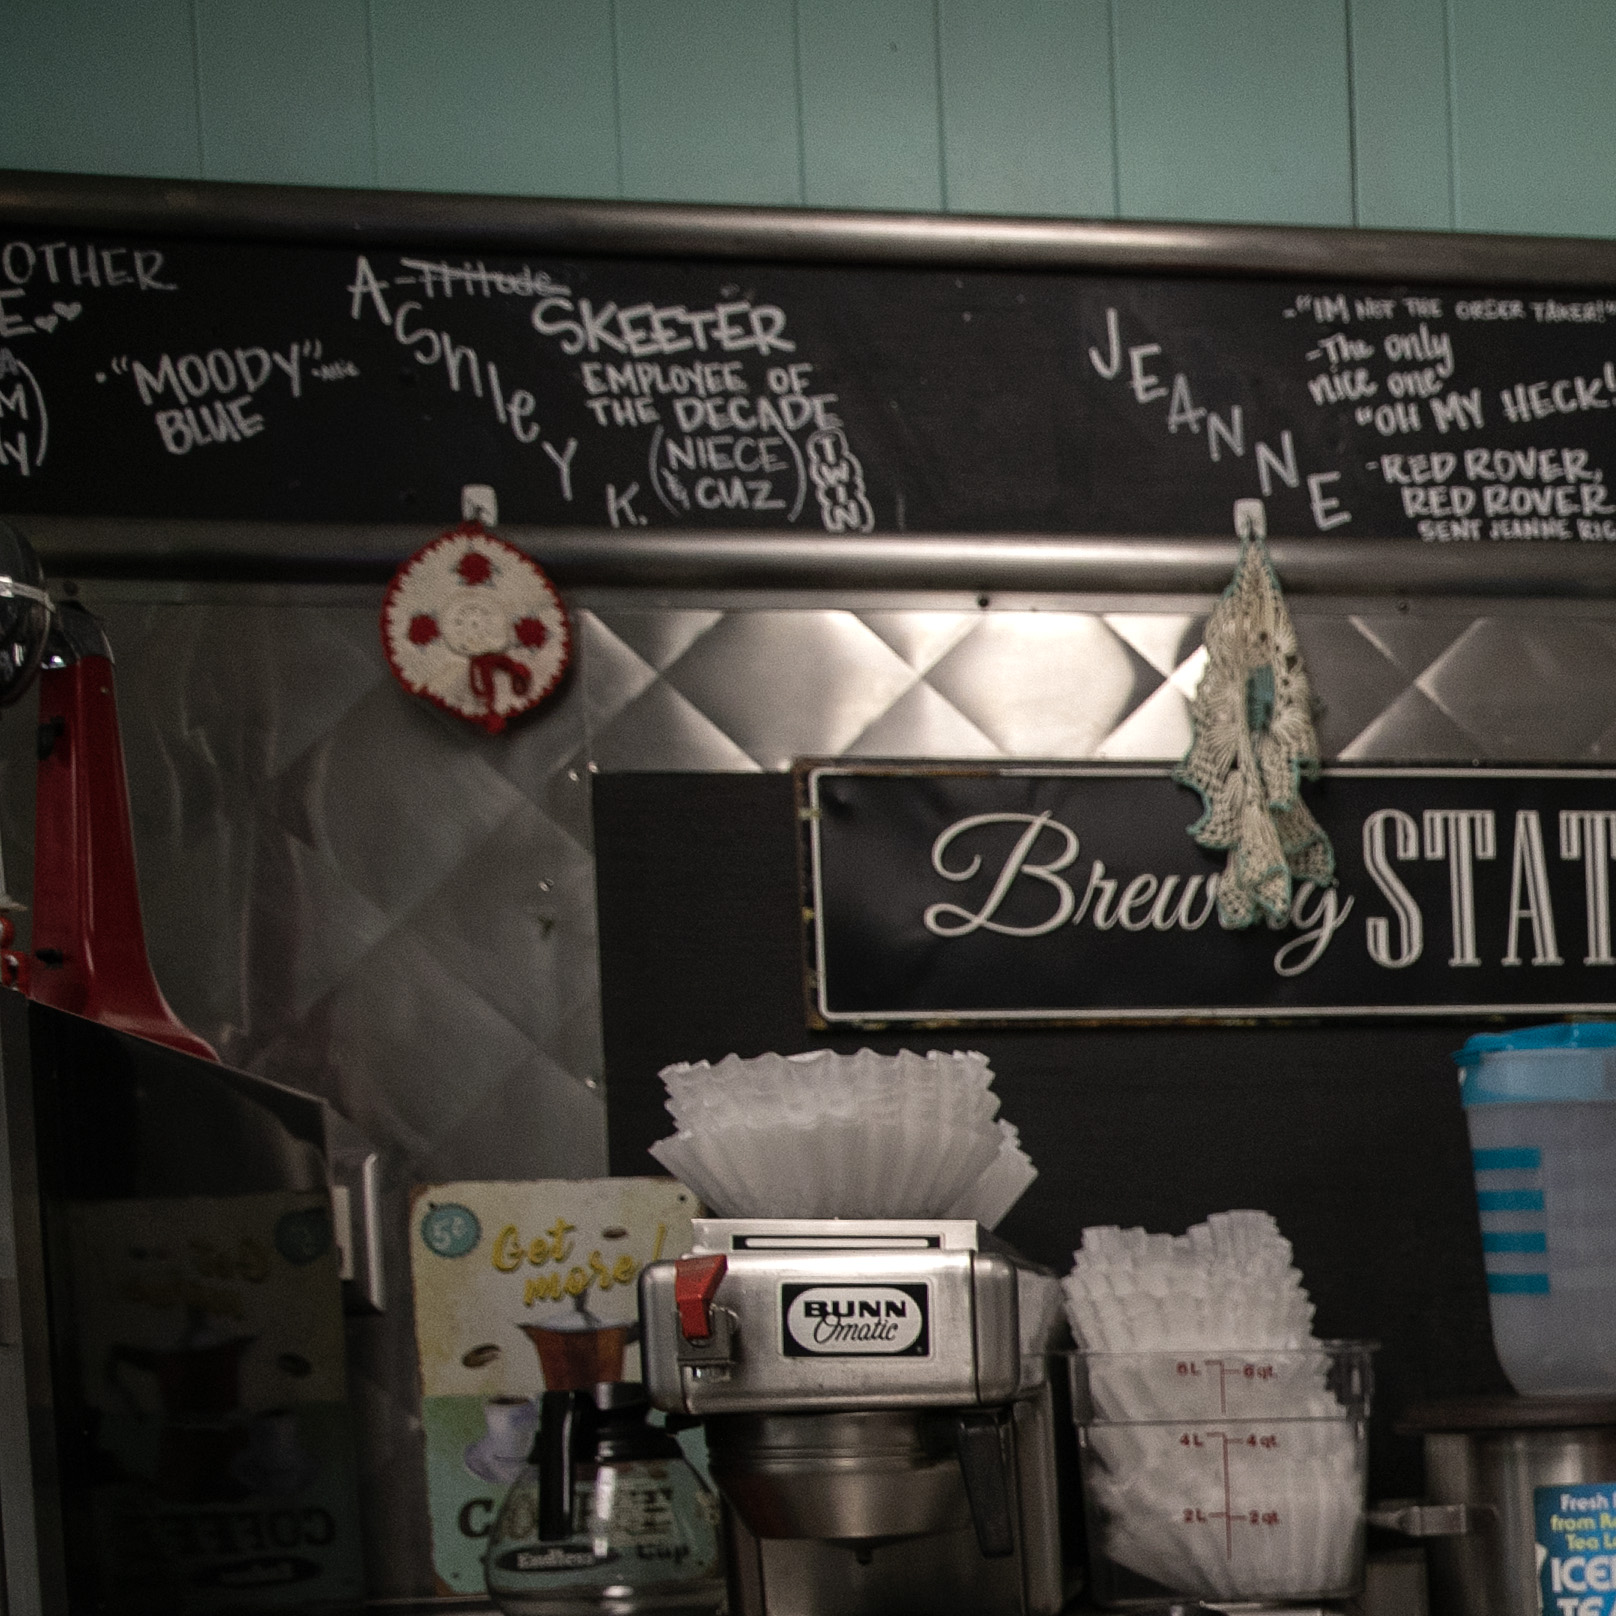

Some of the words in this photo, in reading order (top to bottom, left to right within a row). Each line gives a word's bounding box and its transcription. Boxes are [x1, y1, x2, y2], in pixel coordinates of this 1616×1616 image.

[530, 298, 796, 356] SKEETER
[1356, 299, 1394, 321] NOT
[1402, 296, 1444, 319] THE
[1455, 298, 1526, 322] ORDER
[1383, 321, 1454, 379] only
[581, 362, 745, 398] EMPLOYEE
[768, 362, 813, 397] OF
[1308, 358, 1378, 406] nice
[155, 396, 266, 456] BLUE
[586, 398, 660, 429] THE
[675, 394, 840, 431] DECADE
[1433, 388, 1484, 434] MY
[1401, 485, 1474, 518] RED
[1416, 517, 1483, 543] SENT
[924, 810, 1355, 977] Brewg
[491, 1218, 577, 1273] Get
[803, 1300, 907, 1318] BUNN
[813, 1312, 899, 1345] Omatic
[1560, 1492, 1609, 1512] Fresh
[1551, 1514, 1596, 1532] from
[1565, 1533, 1599, 1551] Tea
